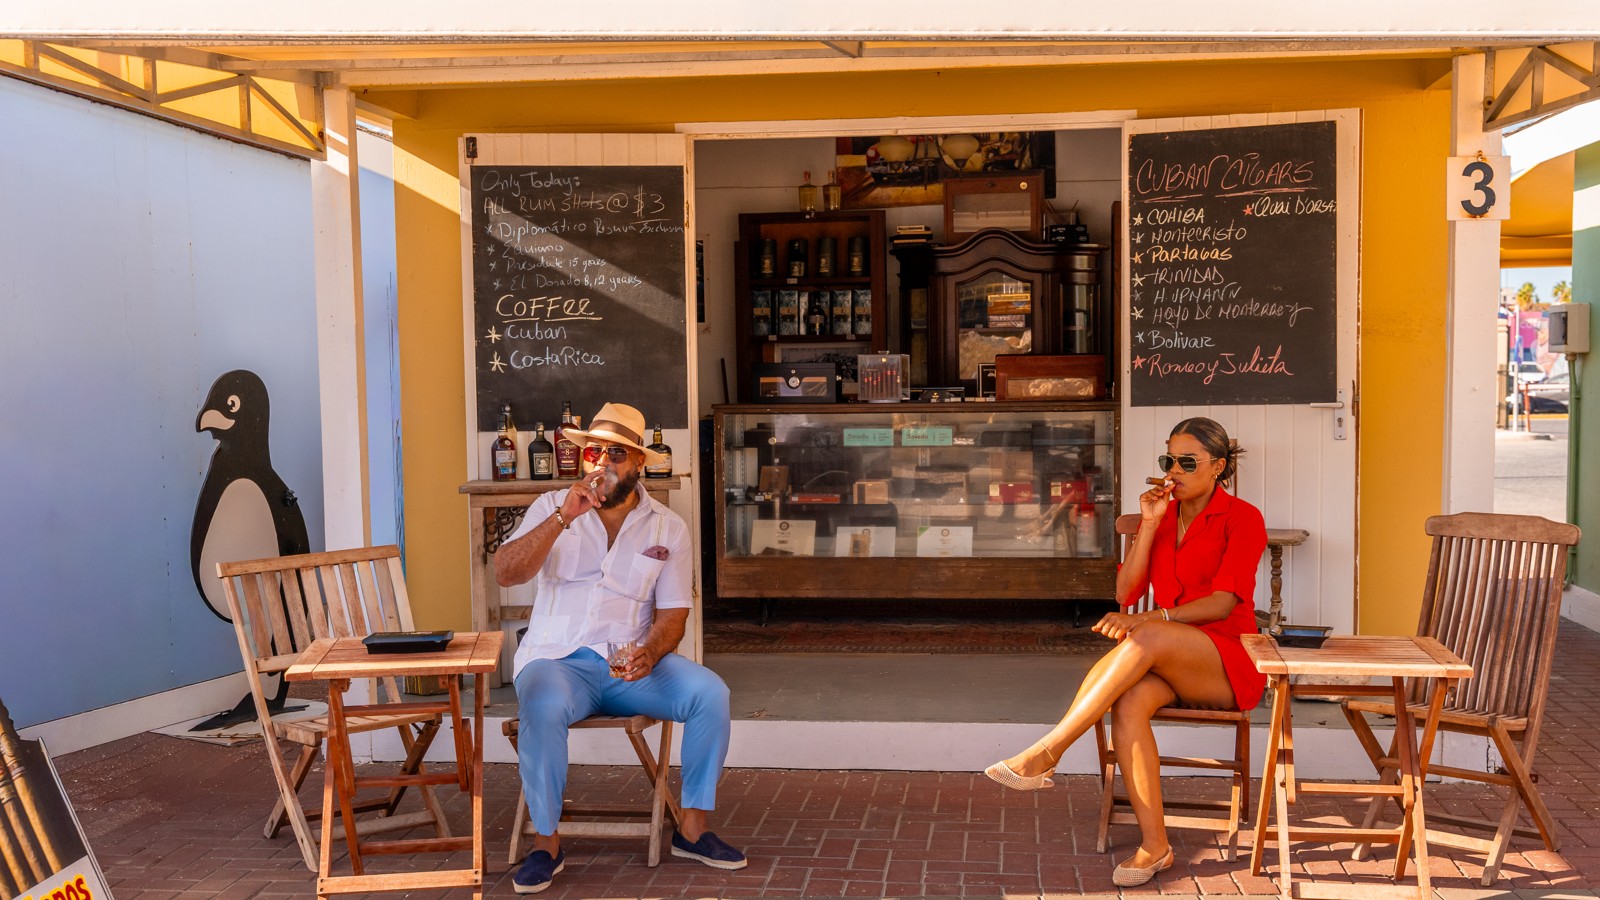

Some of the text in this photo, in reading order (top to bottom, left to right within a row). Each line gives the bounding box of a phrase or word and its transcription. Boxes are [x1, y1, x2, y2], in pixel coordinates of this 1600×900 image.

[481, 170, 580, 197] Only Today:
[1137, 154, 1229, 194] CUBAN
[1461, 161, 1496, 216] 3
[484, 196, 511, 215] ALL
[519, 195, 555, 212] RUM
[1147, 208, 1205, 225] COHIBA
[569, 258, 579, 268] 15
[507, 321, 567, 341] Cuban
[1219, 345, 1295, 376] Julieta
